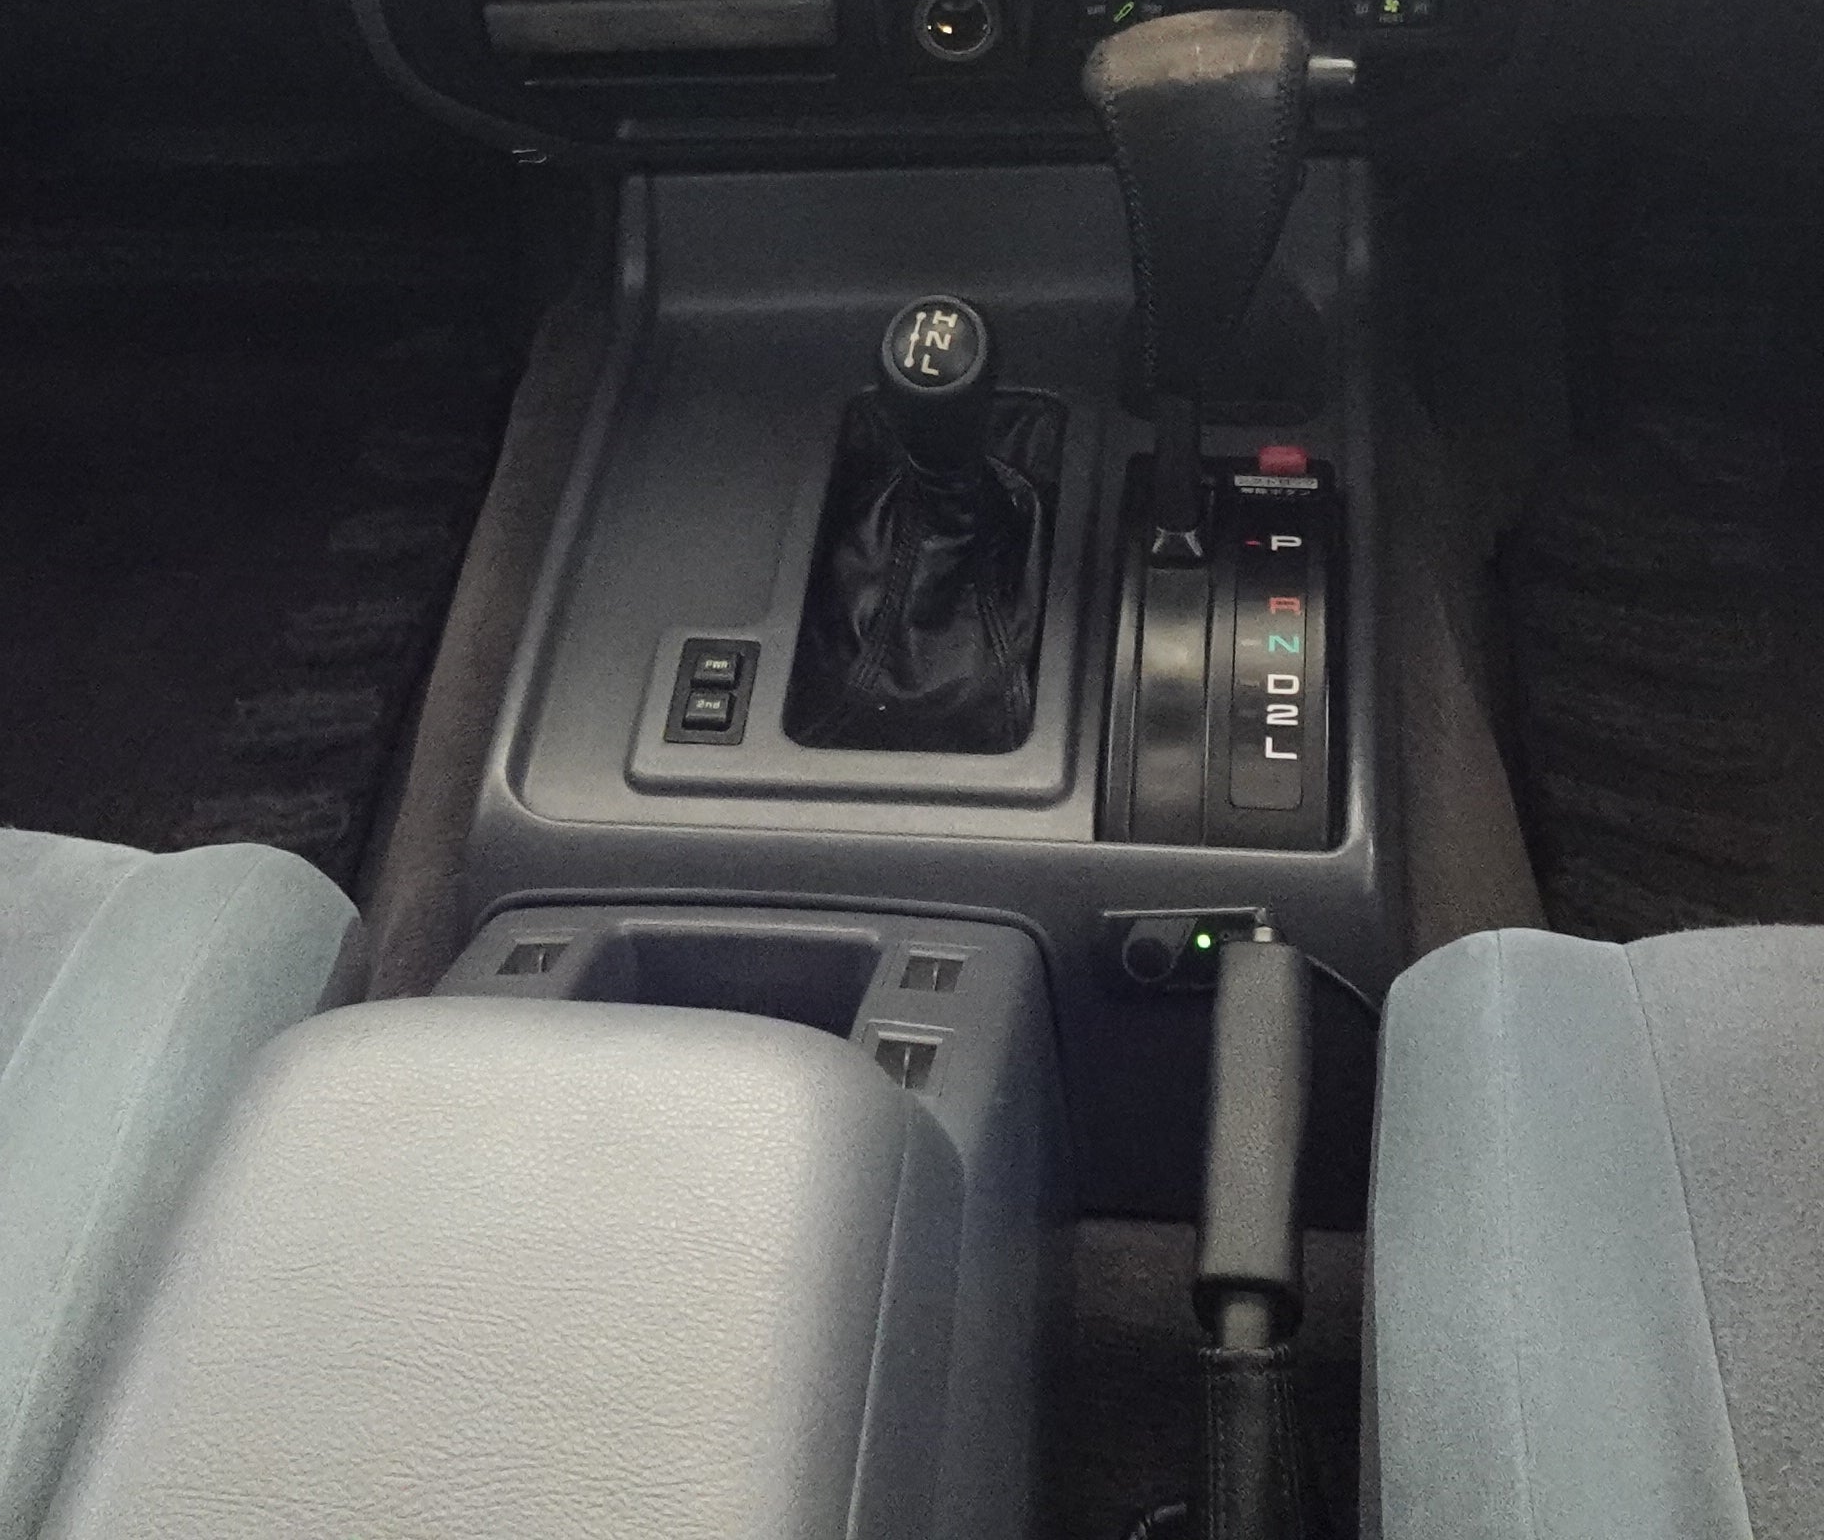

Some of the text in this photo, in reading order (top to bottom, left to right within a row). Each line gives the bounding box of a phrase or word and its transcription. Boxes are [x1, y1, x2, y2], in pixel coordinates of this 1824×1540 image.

[932, 310, 958, 328] H
[925, 330, 951, 350] N
[921, 353, 939, 376] L
[1271, 535, 1302, 551] P
[1269, 596, 1301, 615] R
[1269, 635, 1299, 653] N
[705, 659, 728, 669] PWR
[1267, 674, 1300, 694] D
[696, 699, 721, 709] 2nd
[1266, 704, 1299, 726] 2
[1265, 736, 1298, 760] L
